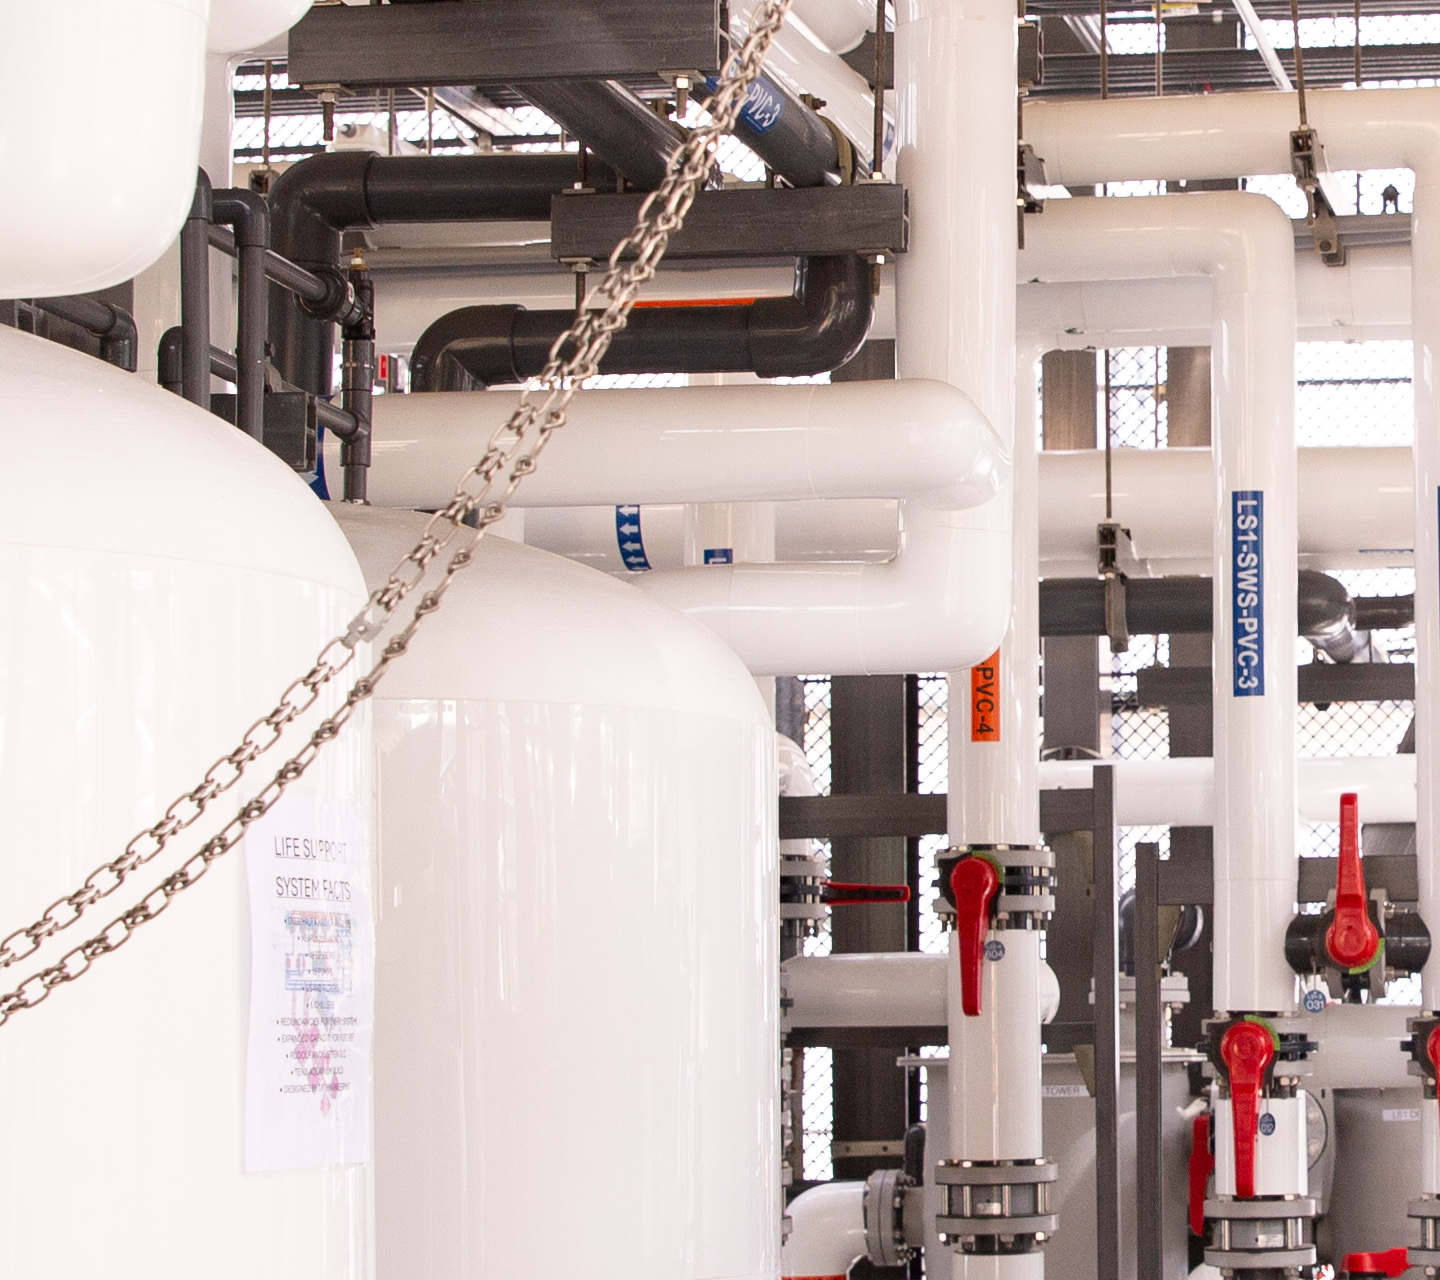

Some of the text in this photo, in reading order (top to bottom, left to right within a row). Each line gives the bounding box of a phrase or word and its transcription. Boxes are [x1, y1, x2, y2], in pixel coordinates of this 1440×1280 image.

[1237, 499, 1259, 689] LS1-SWS-PVC-3
[274, 836, 300, 858] LIFE
[275, 876, 352, 901] SYSTEM FACTS
